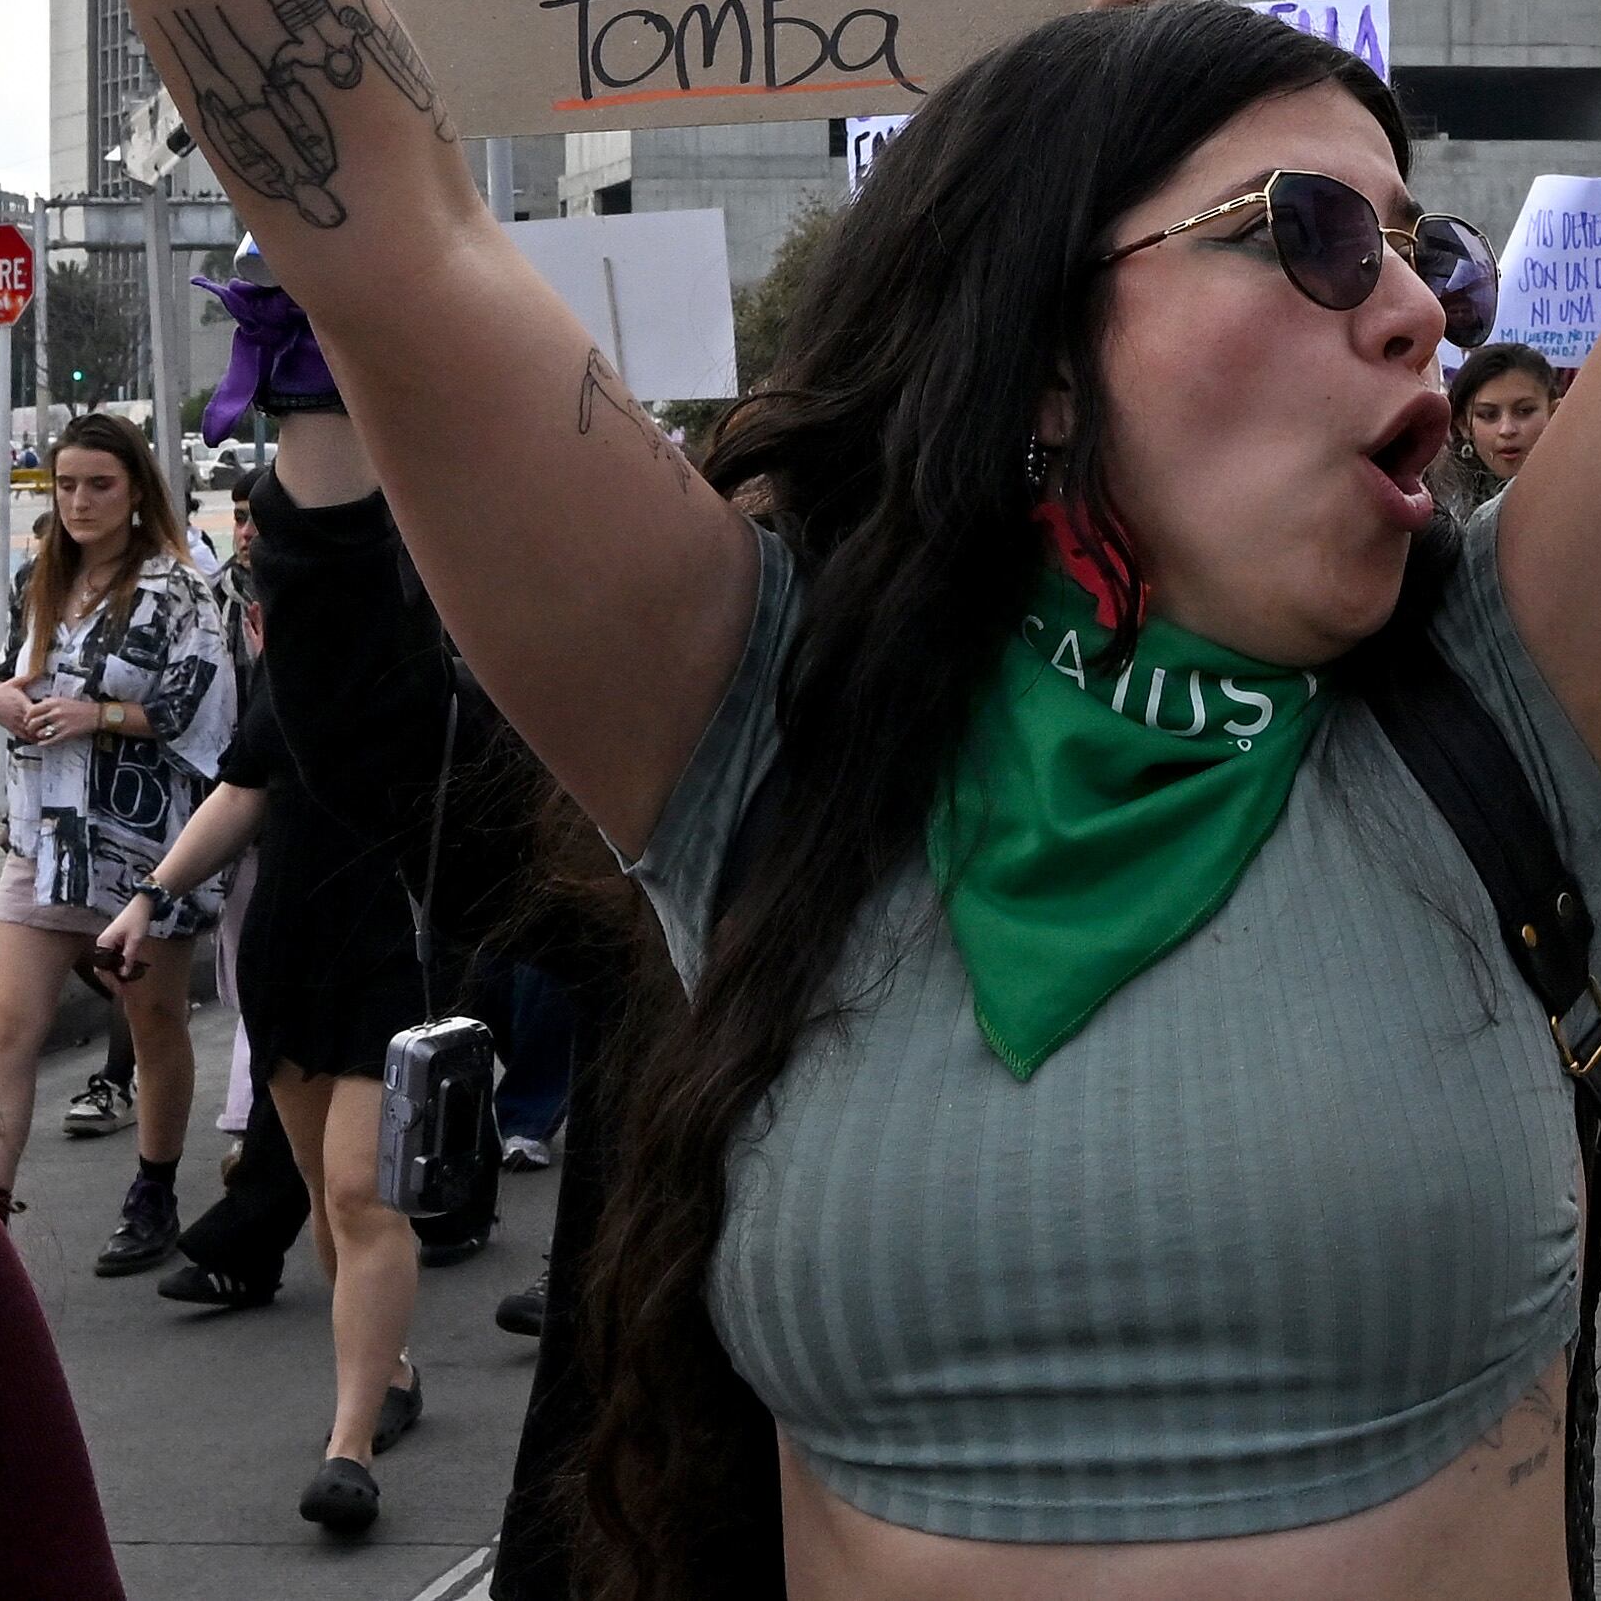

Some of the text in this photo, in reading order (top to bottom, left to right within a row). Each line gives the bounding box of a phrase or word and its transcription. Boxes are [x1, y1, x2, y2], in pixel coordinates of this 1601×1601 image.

[1525, 209, 1554, 248] MIS
[1518, 257, 1558, 293] SON
[1565, 256, 1589, 292] UN
[1530, 297, 1550, 327] NI
[1559, 293, 1594, 325] UNA
[1501, 328, 1519, 343] MI
